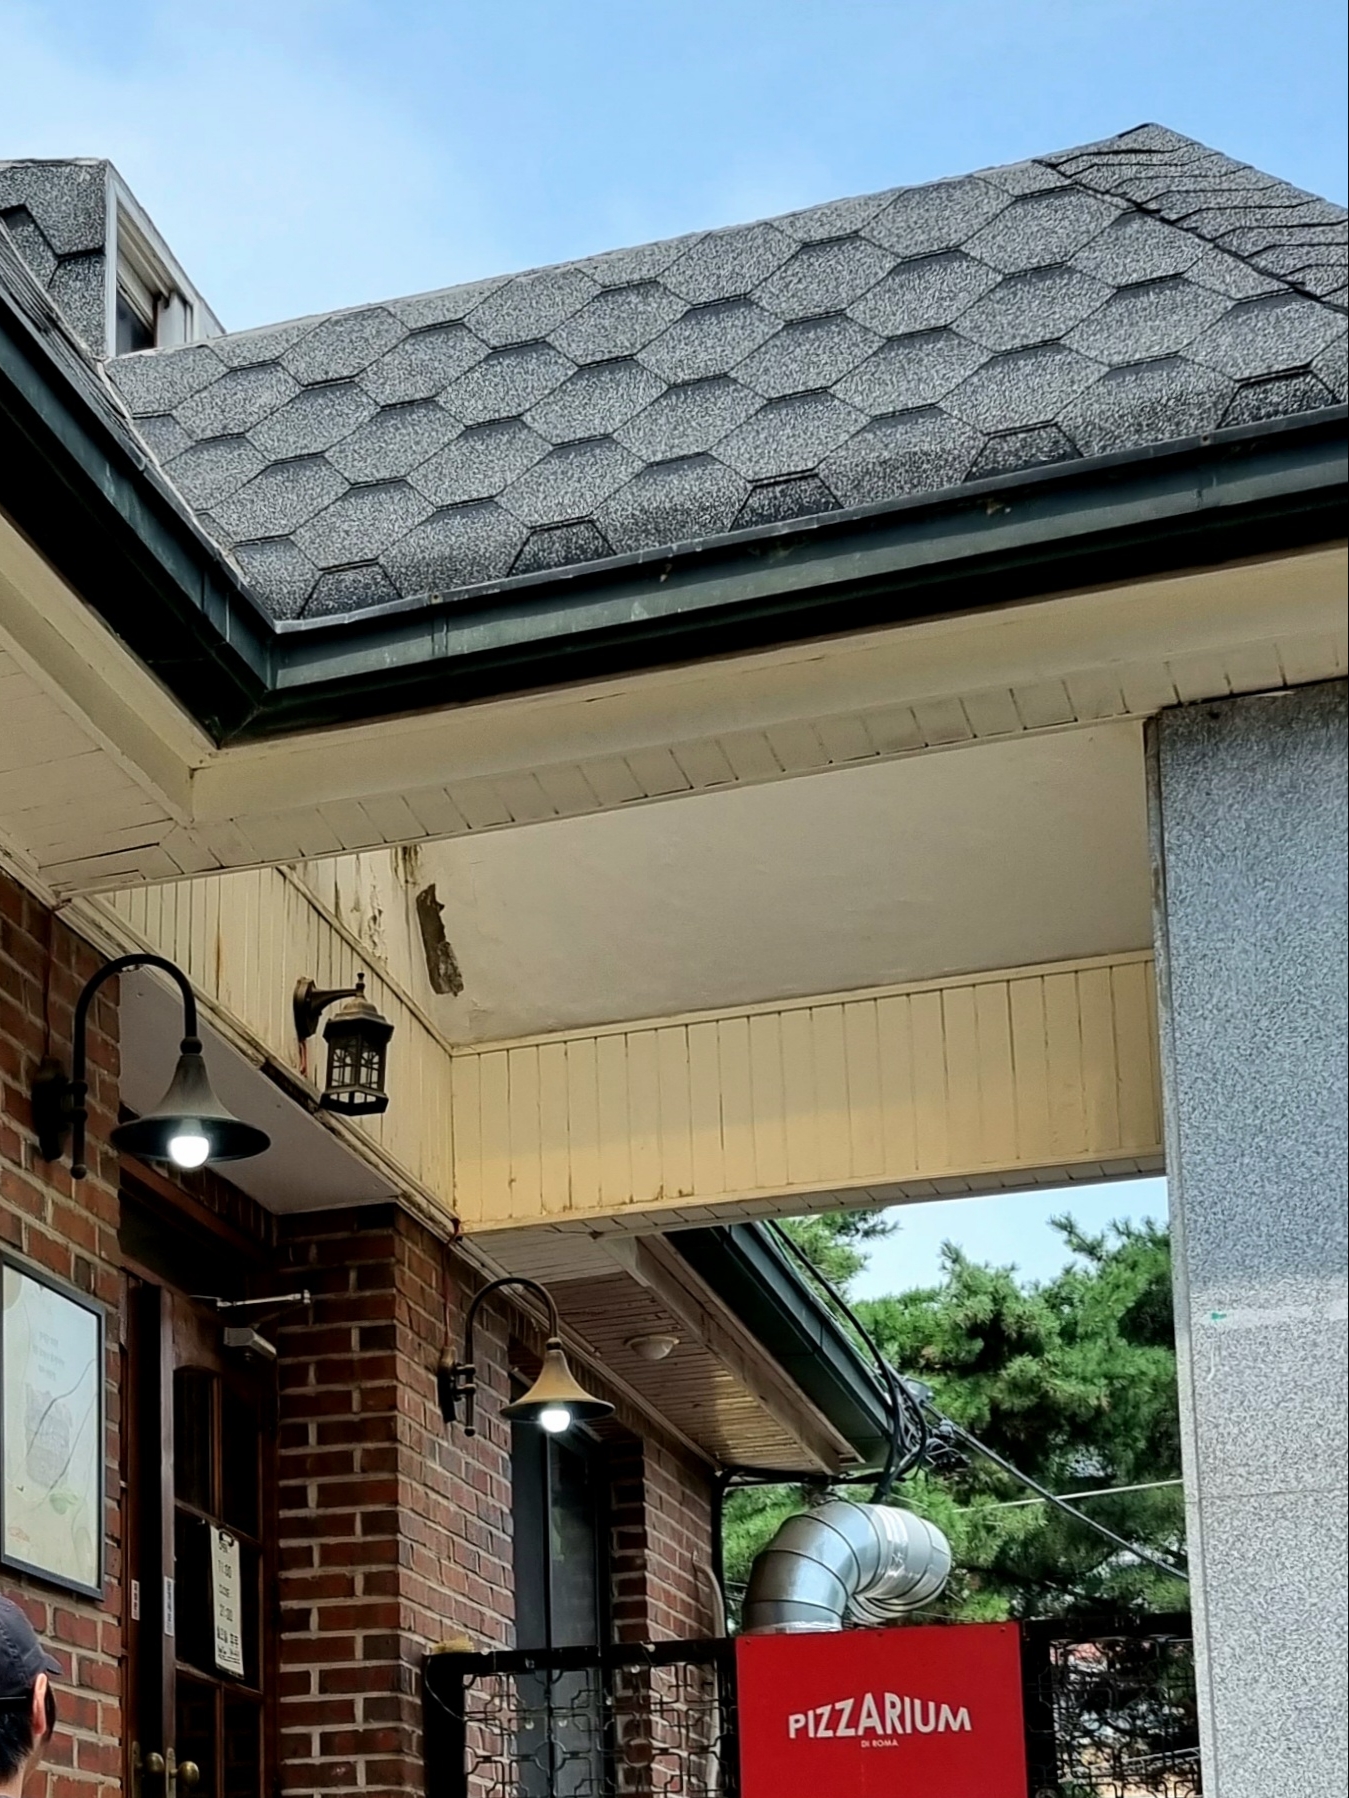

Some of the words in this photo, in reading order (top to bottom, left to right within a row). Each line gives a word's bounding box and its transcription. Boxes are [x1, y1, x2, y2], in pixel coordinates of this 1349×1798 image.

[788, 1692, 972, 1739] PIZZARIUM
[861, 1740, 870, 1748] DI
[872, 1738, 899, 1748] ROMA
